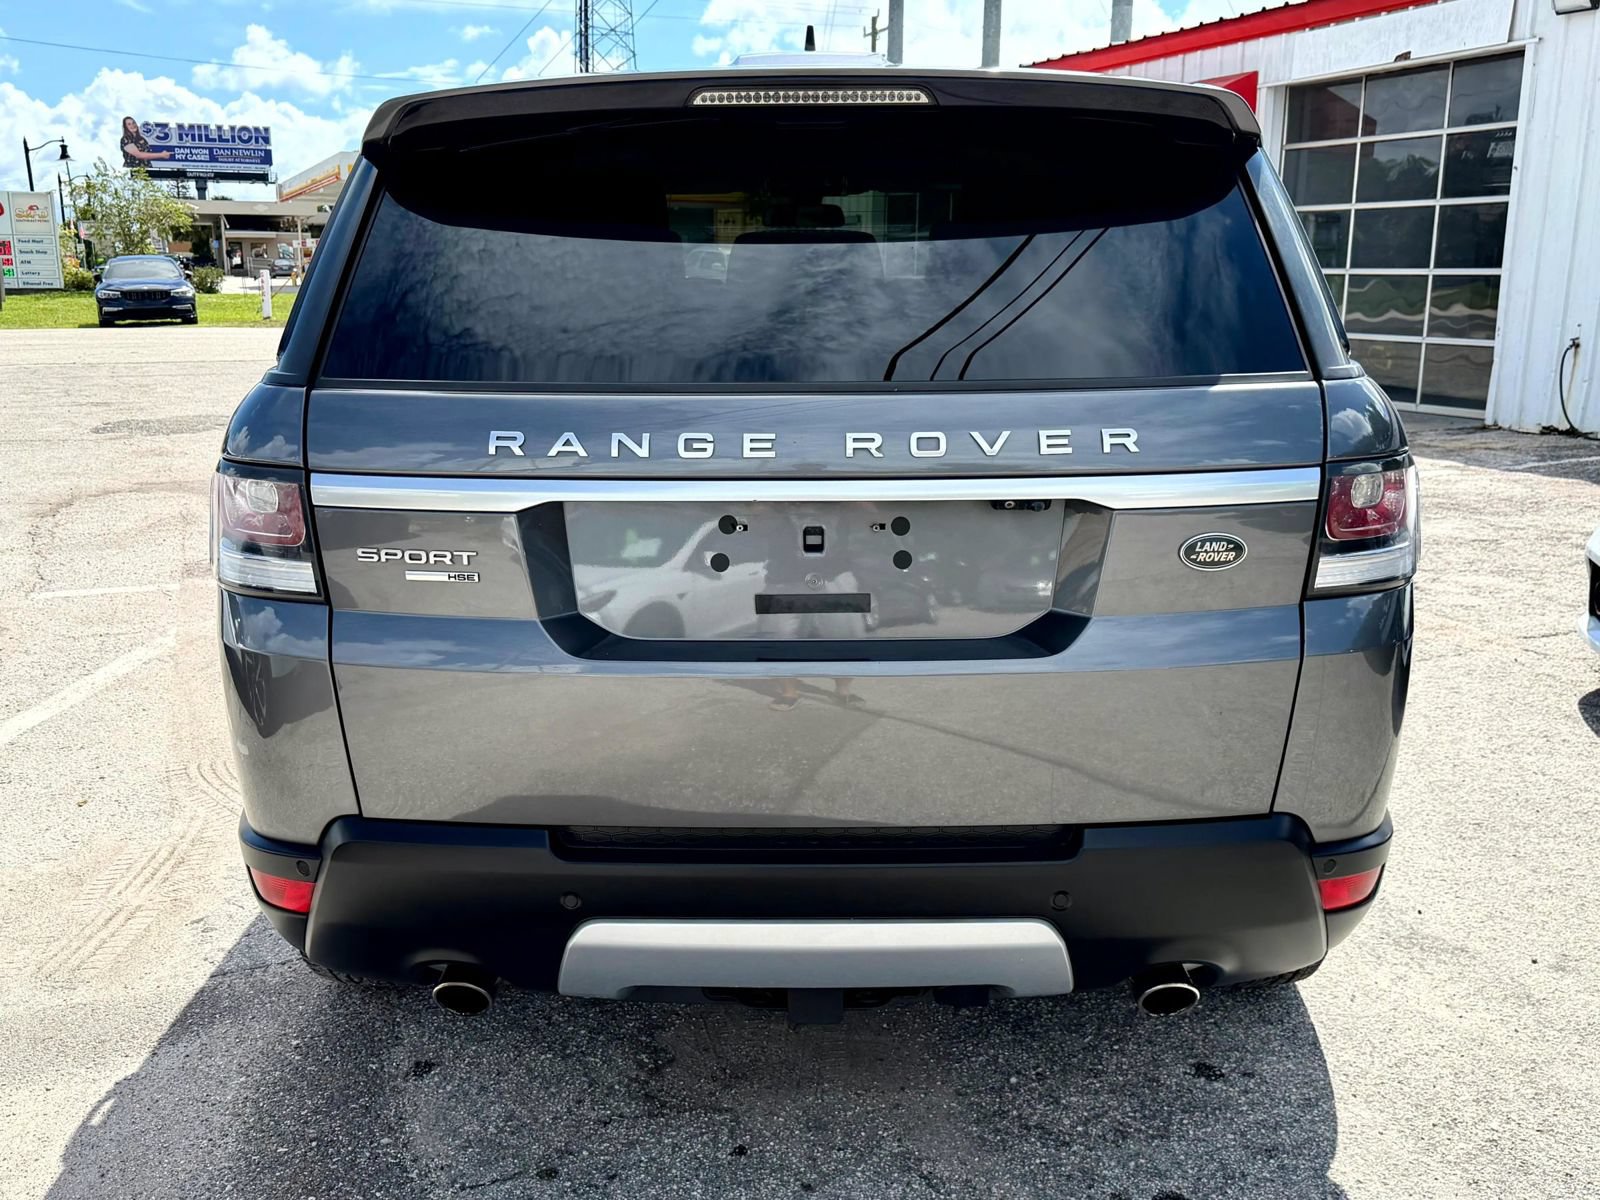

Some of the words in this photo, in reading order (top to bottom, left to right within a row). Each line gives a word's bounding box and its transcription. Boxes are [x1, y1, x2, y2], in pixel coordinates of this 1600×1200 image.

[142, 121, 170, 142] $3
[176, 123, 271, 145] MILLION
[213, 148, 231, 156] DAN
[232, 149, 265, 157] NEWLIN
[488, 431, 776, 458] RANGE
[845, 429, 1140, 458] ROVER
[1195, 541, 1228, 552] LAND
[357, 547, 477, 565] SPORT
[1196, 552, 1236, 562] ROVER
[447, 573, 476, 581] HSE
